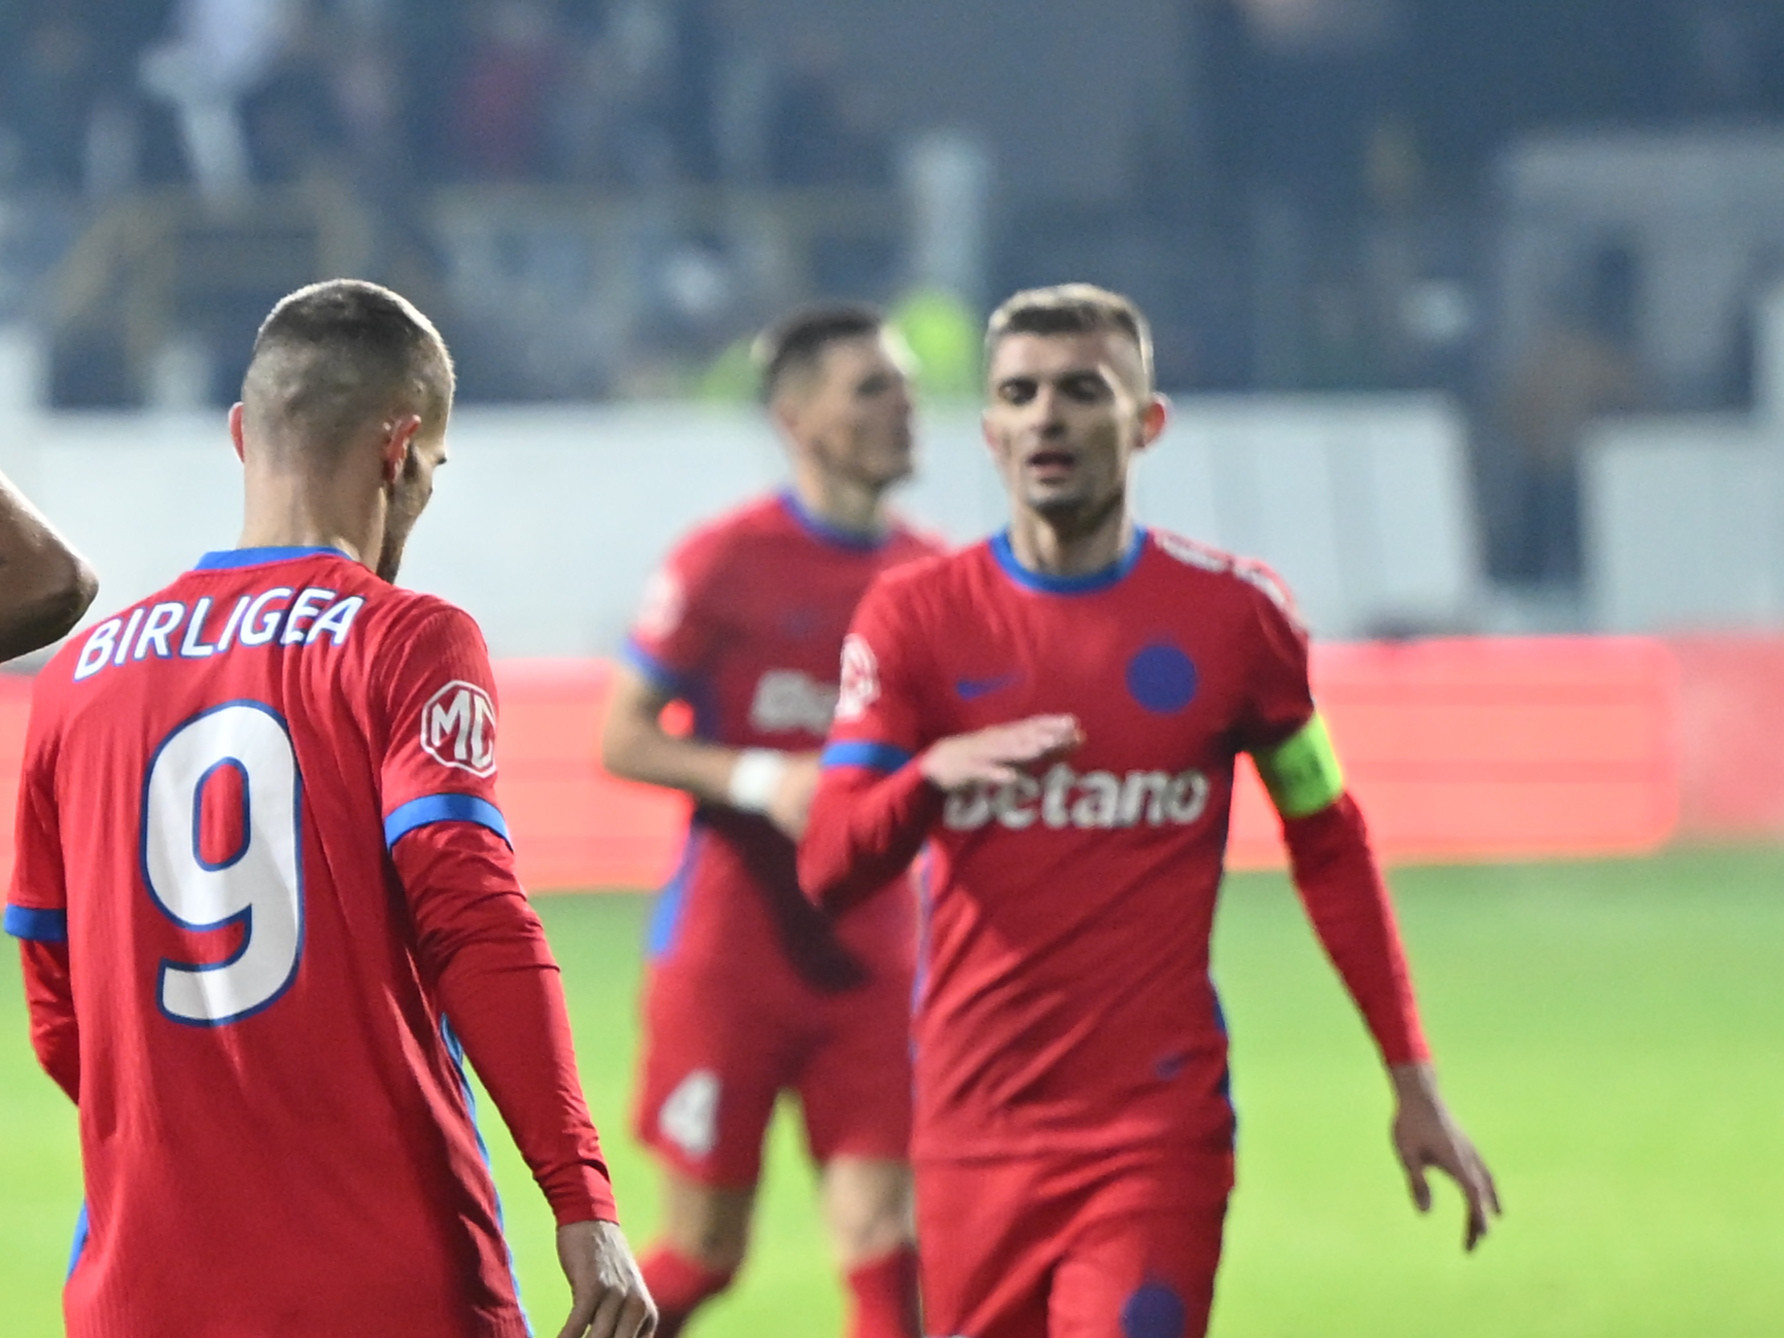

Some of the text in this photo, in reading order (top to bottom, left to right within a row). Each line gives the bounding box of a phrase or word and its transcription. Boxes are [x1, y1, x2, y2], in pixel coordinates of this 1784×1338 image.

[73, 587, 365, 683] BIRLIGEA
[139, 698, 304, 1028] 9
[658, 1069, 722, 1154] 4
